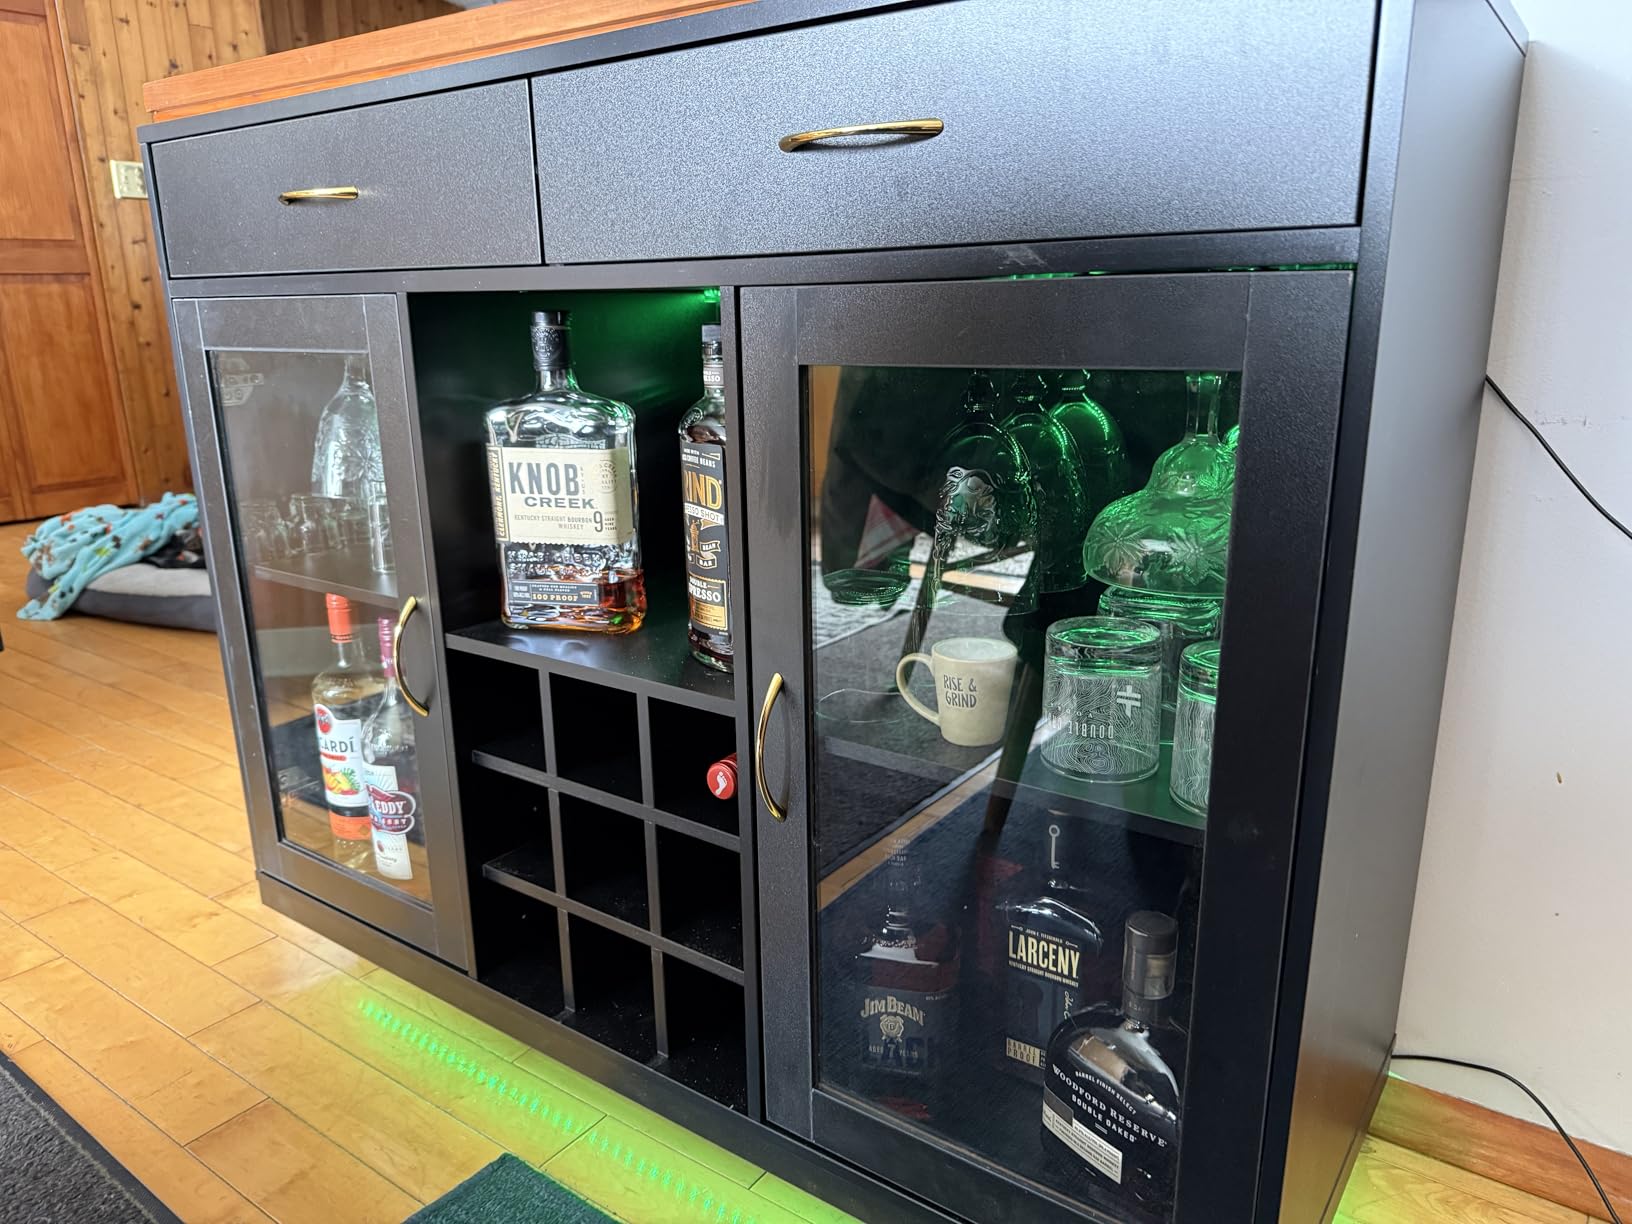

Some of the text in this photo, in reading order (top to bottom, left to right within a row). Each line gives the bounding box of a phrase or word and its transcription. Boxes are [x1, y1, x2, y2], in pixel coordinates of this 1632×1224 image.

[508, 462, 580, 496] KNOB
[524, 496, 595, 510] CREEK
[514, 514, 592, 524] KENTUCKY STRAIGHT BOURBON
[593, 511, 603, 532] 9
[700, 510, 720, 520] SHOT
[558, 522, 584, 530] WHISKEY
[944, 674, 977, 692] RISE &
[945, 690, 977, 708] GRIND
[1068, 721, 1114, 739] DOUBLE
[1008, 930, 1080, 979] LARCENY
[861, 995, 924, 1026] JIM BEAM
[1008, 1047, 1035, 1064] PROOF
[1075, 1070, 1136, 1115] BARREL FINISH SELECT
[1052, 1064, 1106, 1111] WOODFORD
[1110, 1107, 1167, 1148] RESERVE
[1072, 1094, 1103, 1122] DOUBLE
[1105, 1119, 1136, 1143] OAKED
